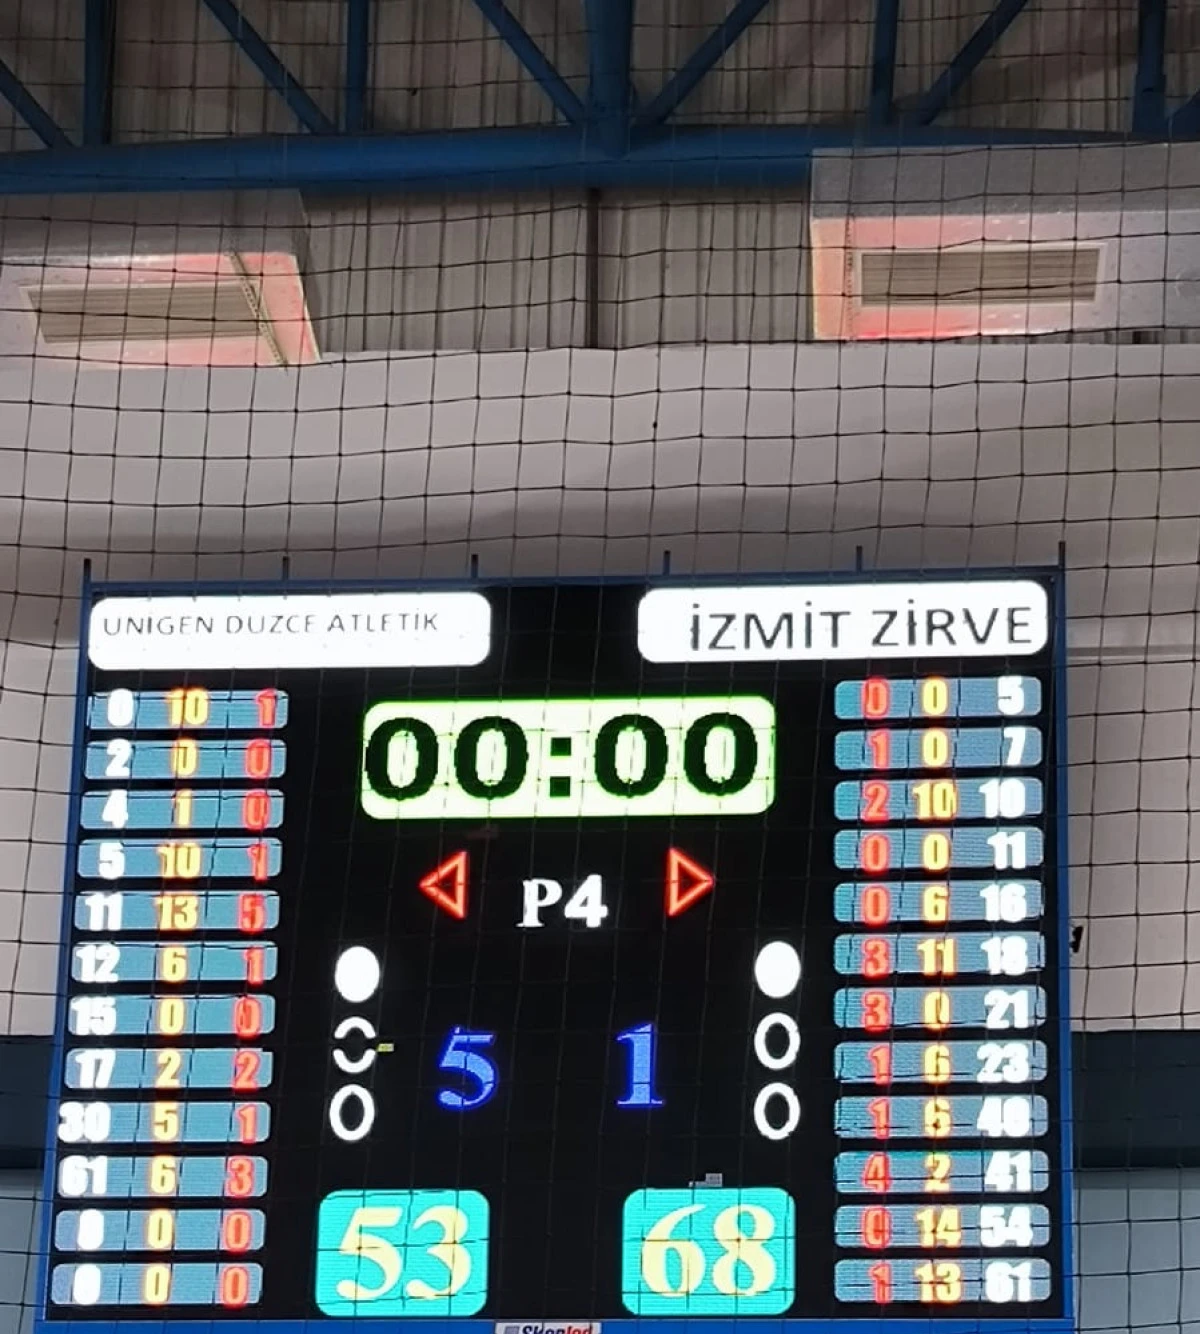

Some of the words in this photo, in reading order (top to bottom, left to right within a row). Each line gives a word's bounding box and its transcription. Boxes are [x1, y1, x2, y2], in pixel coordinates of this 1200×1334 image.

[690, 601, 851, 651] İZMİT
[871, 598, 1032, 647] ZİRVE
[166, 688, 209, 726] 10
[256, 688, 276, 728] 1
[862, 678, 889, 719] 0
[923, 679, 948, 716] 0
[997, 676, 1024, 715] 5
[106, 739, 132, 777] 2
[172, 739, 197, 776] 0
[245, 739, 271, 780] 0
[365, 712, 758, 801] 00:00
[868, 728, 890, 769] 1
[923, 730, 948, 766] 0
[1003, 727, 1026, 766] 7
[102, 790, 128, 828] 4
[174, 790, 192, 827] 1
[243, 790, 270, 830] 0
[862, 780, 890, 821] 2
[913, 781, 957, 818] 10
[979, 779, 1026, 818] 10
[99, 842, 125, 879] 5
[157, 842, 201, 878] 10
[248, 841, 267, 881] 1
[862, 832, 890, 871] 0
[923, 833, 949, 870] 0
[987, 831, 1026, 870] 11
[85, 892, 123, 931] 11
[156, 894, 198, 930] 13
[239, 893, 265, 933] 5
[515, 873, 609, 928] P4
[862, 885, 890, 924] 0
[923, 886, 949, 922] 6
[979, 883, 1027, 923] 16
[76, 943, 120, 983] 12
[162, 946, 188, 983] 6
[244, 947, 264, 984] 1
[862, 937, 890, 978] 3
[917, 938, 955, 975] 11
[71, 996, 116, 1035] 15
[159, 997, 184, 1035] 0
[234, 997, 262, 1038] 0
[862, 990, 890, 1030] 3
[924, 991, 950, 1029] 0
[984, 989, 1029, 1029] 21
[75, 1049, 116, 1088] 17
[156, 1050, 180, 1088] 2
[233, 1050, 261, 1090] 2
[438, 1025, 496, 1107] 5
[615, 1023, 664, 1105] 1
[868, 1043, 891, 1085] 1
[924, 1044, 950, 1083] 6
[976, 1042, 1030, 1083] 23
[57, 1101, 111, 1142] 30
[154, 1102, 179, 1141] 5
[236, 1103, 257, 1144] 1
[869, 1097, 890, 1139] 1
[924, 1098, 951, 1137] 6
[61, 1155, 107, 1195] 61
[151, 1155, 176, 1193] 6
[227, 1155, 254, 1196] 3
[863, 1152, 890, 1193] 4
[925, 1152, 951, 1192] 2
[984, 1151, 1031, 1191] 41
[148, 1209, 173, 1249] 0
[224, 1211, 252, 1253] 0
[862, 1207, 890, 1248] 0
[916, 1207, 961, 1247] 14
[980, 1206, 1033, 1247] 54
[335, 1205, 472, 1301] 53
[641, 1204, 776, 1297] 68
[145, 1264, 170, 1304] 0
[222, 1266, 249, 1306] 0
[868, 1262, 891, 1303] 1
[915, 1262, 961, 1303] 13
